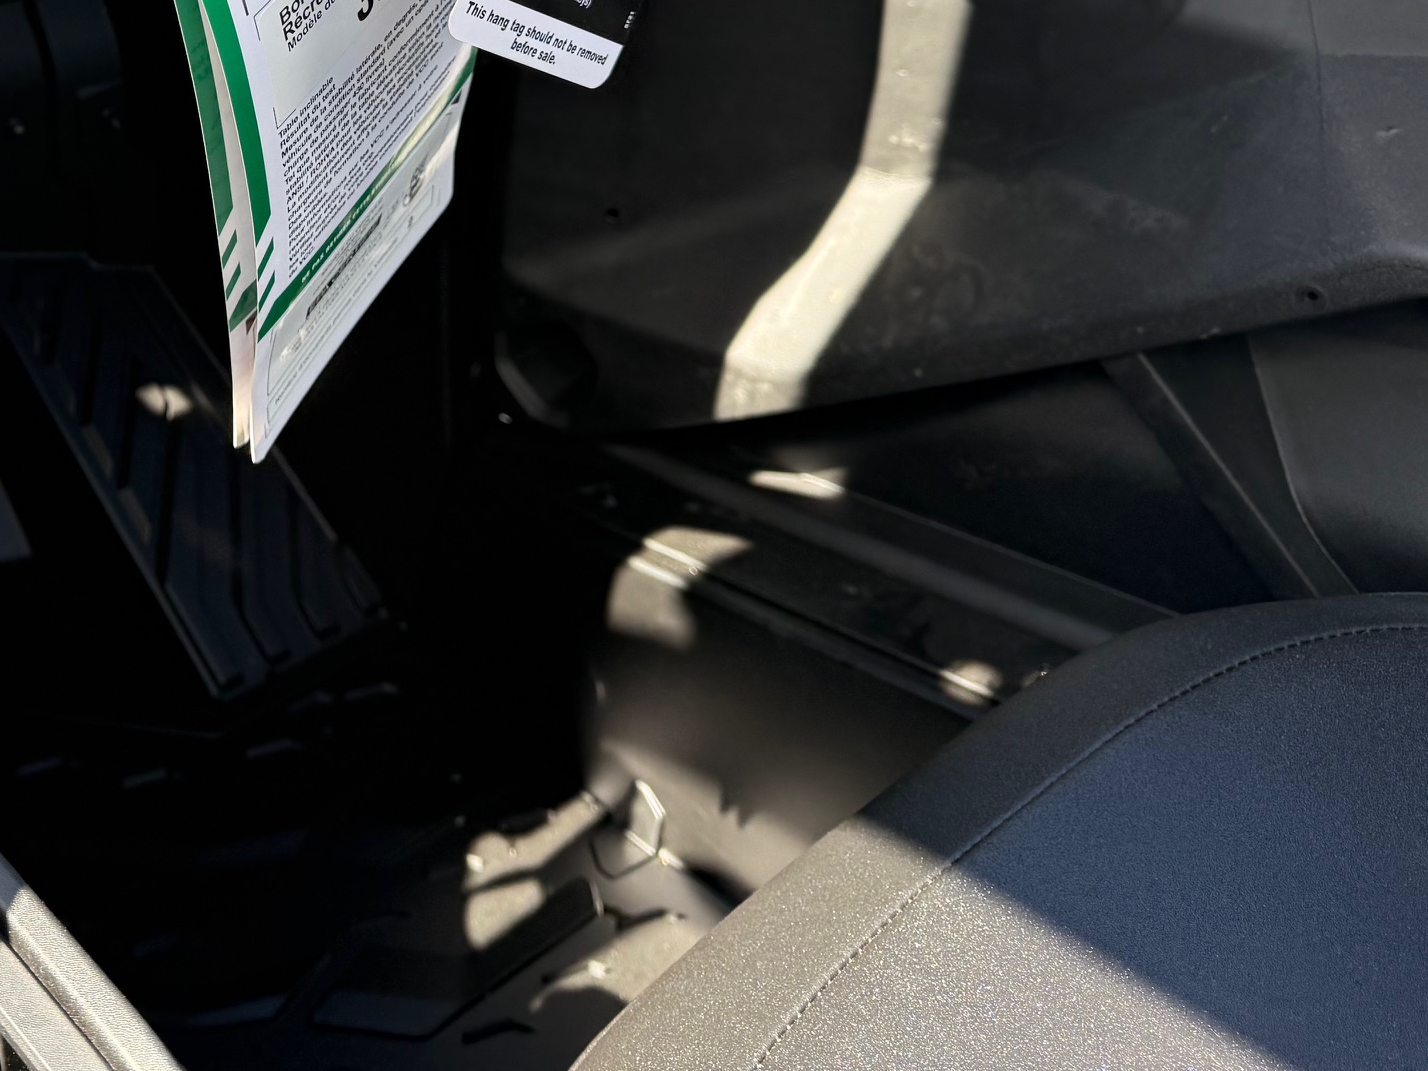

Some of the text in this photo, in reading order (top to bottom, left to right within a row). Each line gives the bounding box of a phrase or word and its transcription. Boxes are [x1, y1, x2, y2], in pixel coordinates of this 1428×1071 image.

[287, 1, 323, 51] Modèle
[465, 0, 607, 67] This hang tag should not be removed
[510, 36, 557, 66] before sale.
[278, 77, 333, 138] Table inclinable
[280, 113, 310, 149] Résultat
[322, 84, 335, 102] test
